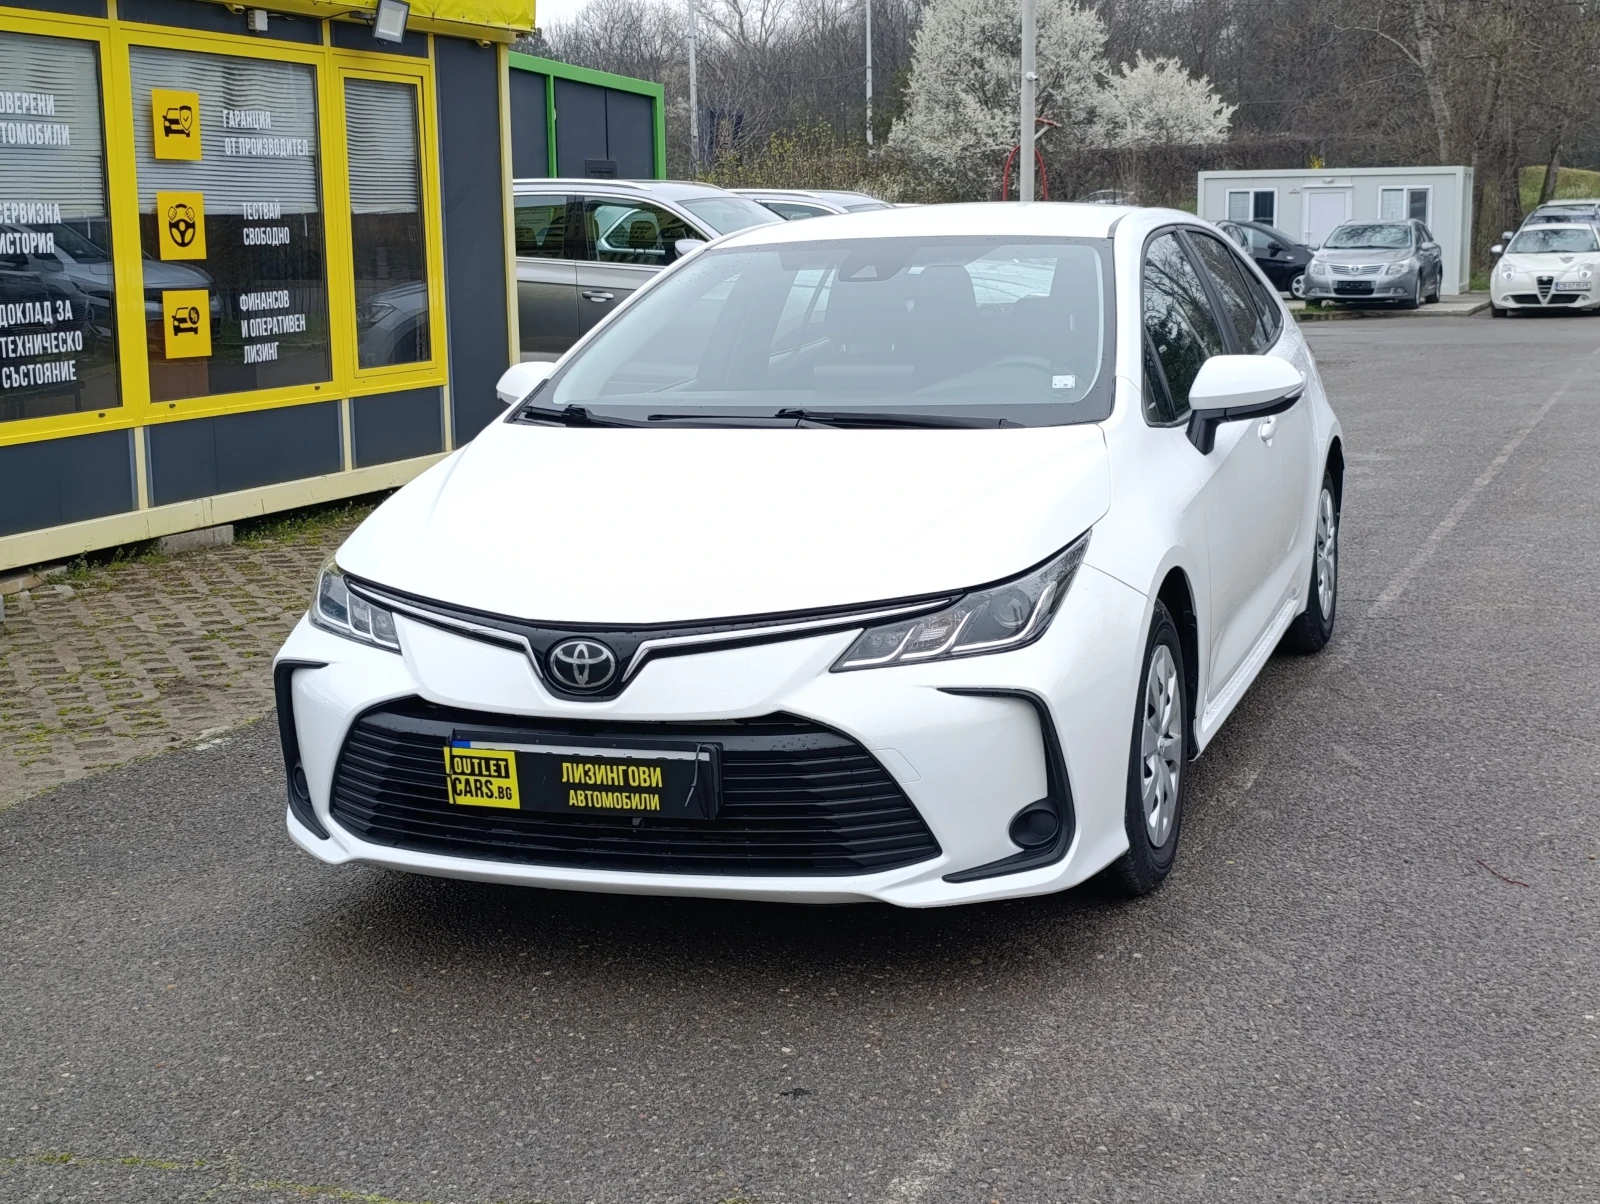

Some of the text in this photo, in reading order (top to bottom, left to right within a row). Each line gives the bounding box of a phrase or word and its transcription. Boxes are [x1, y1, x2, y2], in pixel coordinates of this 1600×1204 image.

[223, 110, 272, 130] ГАРАНЦИЯ
[0, 122, 70, 146] ТОМОБИЛИ
[225, 138, 309, 157] ОТ ПРОИЗВОДИТЕЛ
[242, 199, 281, 220] ТЕСТВАЙ
[243, 226, 290, 247] СВОБОДНО
[240, 290, 290, 312] ФИНАНСОВ
[0, 300, 73, 328] ДОКЛАД ЗА
[241, 313, 306, 338] И ОПЕРАТИВЕН
[0, 330, 83, 358] ТЕХНИЧЕСКО
[244, 342, 279, 364] ЛИЗИНГ
[2, 360, 77, 388] СЪСТОЯНИЕ
[454, 757, 506, 777] OUTLET
[562, 763, 663, 788] ЛИЗИНГОВИ
[453, 777, 512, 800] CARS.BG
[569, 790, 660, 811] АВТОМОБИЛИ
